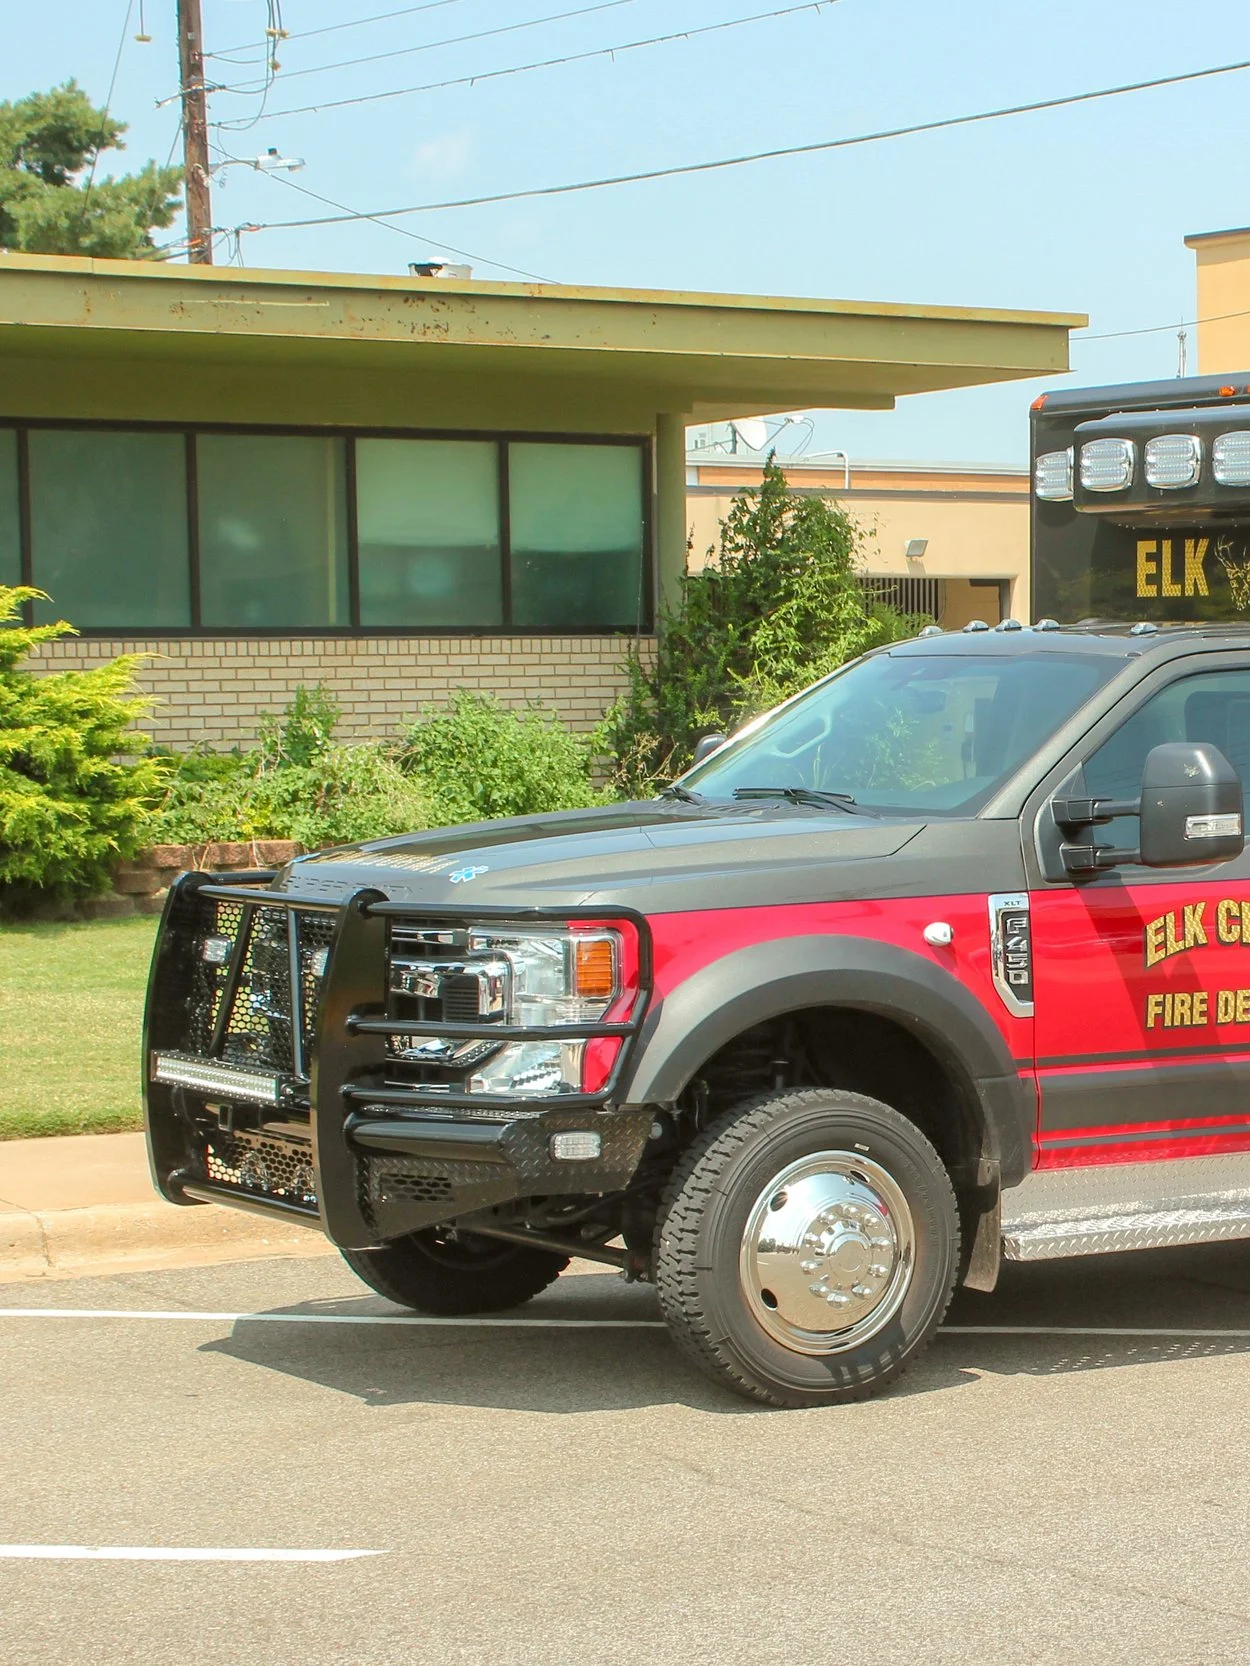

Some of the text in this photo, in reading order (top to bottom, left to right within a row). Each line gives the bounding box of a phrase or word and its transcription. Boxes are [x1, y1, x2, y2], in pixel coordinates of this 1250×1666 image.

[1136, 538, 1210, 598] ELK
[1145, 901, 1208, 969] ELK
[1145, 991, 1208, 1030] FIRE
